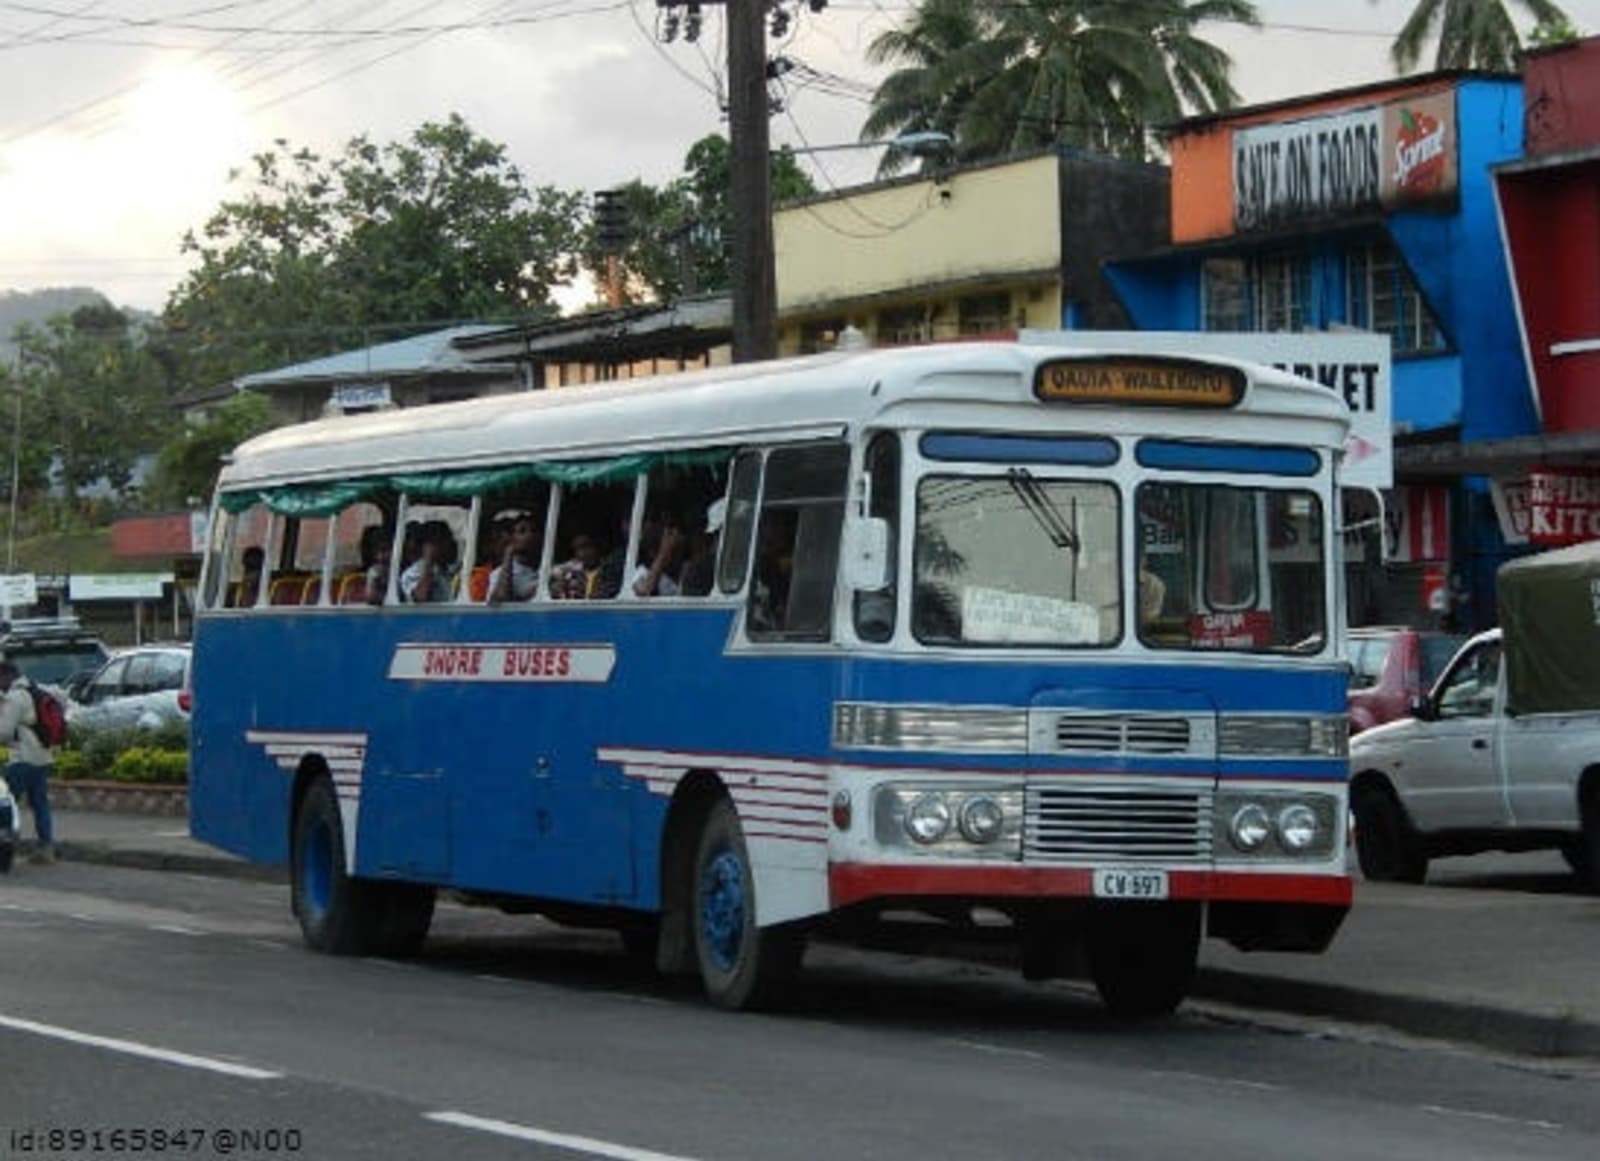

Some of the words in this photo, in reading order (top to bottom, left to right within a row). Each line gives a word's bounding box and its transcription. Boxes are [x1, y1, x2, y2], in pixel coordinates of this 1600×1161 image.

[1237, 141, 1281, 225] SAVE
[1286, 134, 1312, 212] ON
[1317, 123, 1380, 210] FOODS
[503, 650, 571, 676] BUSES
